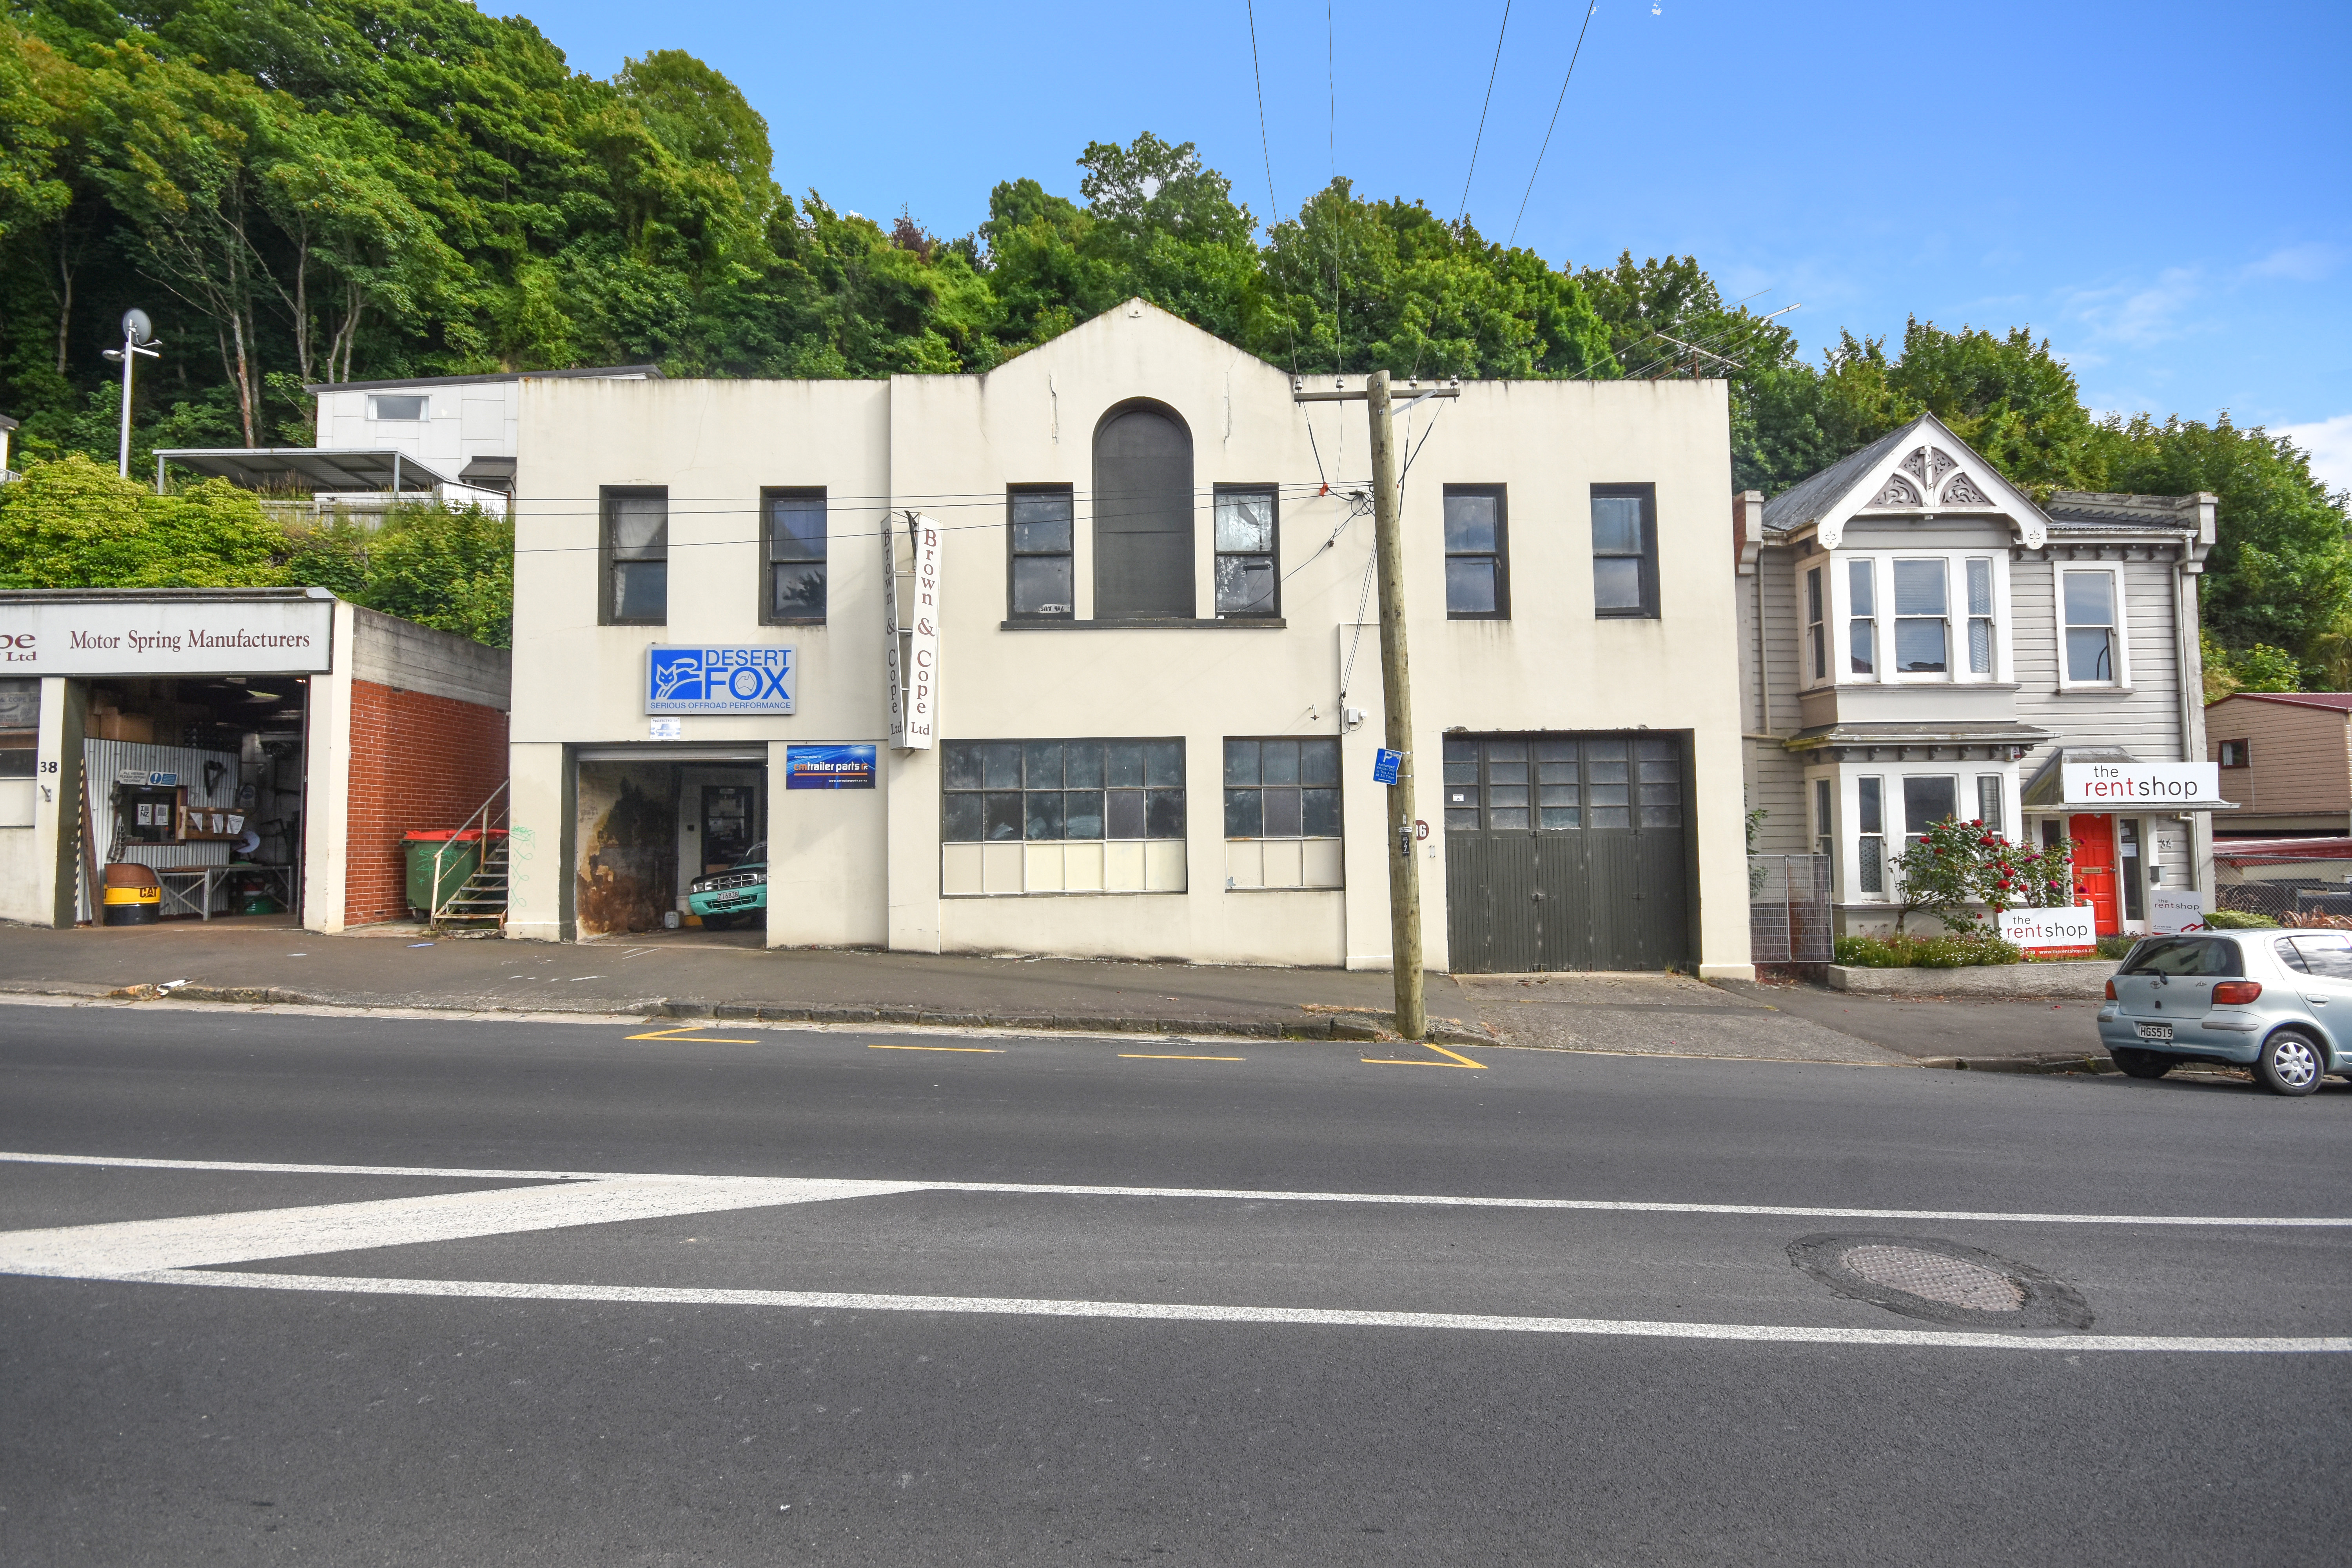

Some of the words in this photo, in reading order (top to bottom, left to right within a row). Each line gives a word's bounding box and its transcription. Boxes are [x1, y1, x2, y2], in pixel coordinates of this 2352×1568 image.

[884, 528, 893, 605] Brown
[921, 528, 937, 606] Brown
[887, 618, 896, 635] &
[918, 617, 935, 637] &
[70, 630, 120, 649] Motor
[128, 630, 181, 653] Spring
[187, 628, 310, 647] Manufacturers
[6, 651, 37, 661] Ltd
[706, 650, 792, 666] DESERT
[705, 666, 790, 701] FOX
[889, 649, 897, 713] Cope
[917, 650, 931, 713] Cope
[891, 721, 902, 735] Ltd
[911, 722, 929, 735] Ltd
[1383, 751, 1393, 762] P
[40, 761, 58, 773] 38
[794, 762, 834, 771] cmtrailer
[836, 761, 860, 773] parts
[2094, 765, 2118, 777] the
[2161, 838, 2172, 849] 34
[140, 887, 158, 898] CAT
[2013, 916, 2031, 924] the
[2141, 1027, 2173, 1038] HGS519
